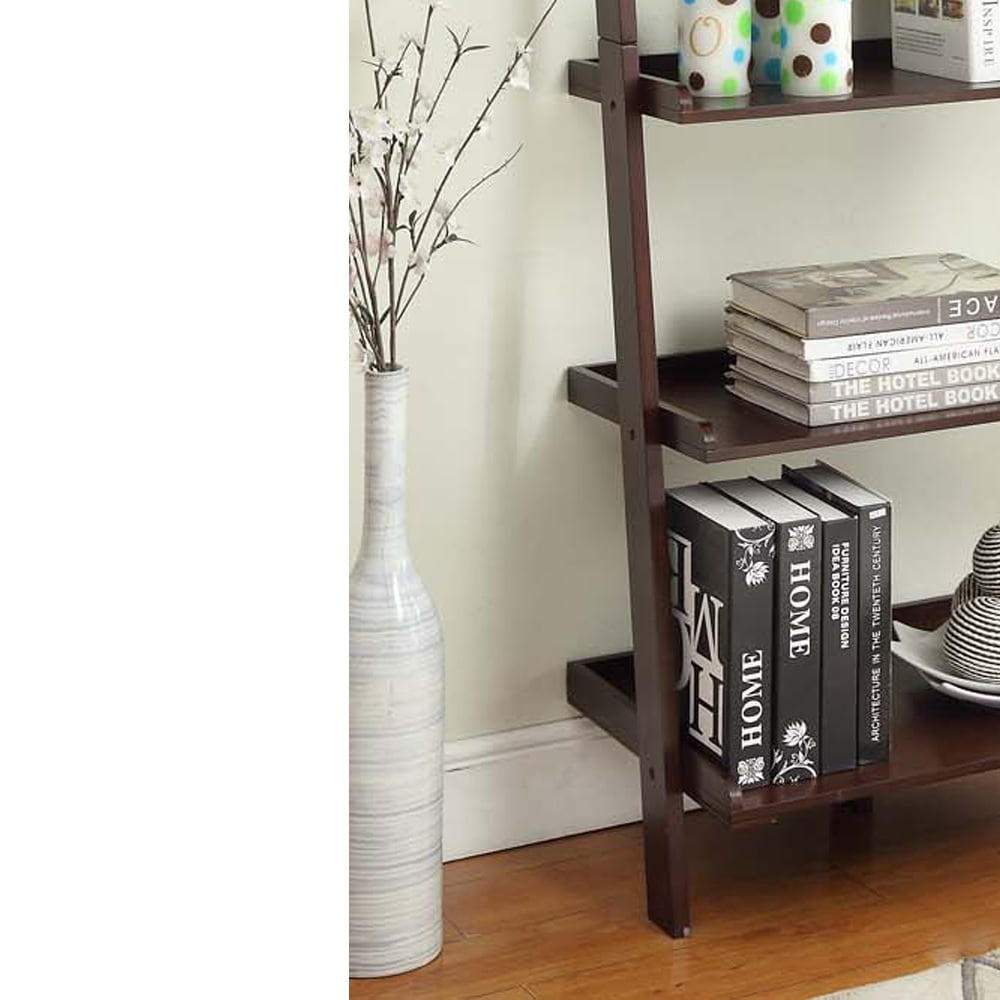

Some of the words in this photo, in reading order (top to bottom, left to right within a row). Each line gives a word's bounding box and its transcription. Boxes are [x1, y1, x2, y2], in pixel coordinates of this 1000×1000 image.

[980, 1, 998, 68] INSPIRE
[832, 357, 891, 378] DECOR
[832, 378, 872, 397] THE
[877, 368, 942, 391] HOTEL
[830, 400, 871, 420] THE
[875, 392, 938, 417] HOTEL
[944, 383, 999, 408] BOOK
[831, 543, 840, 570] IDEA
[871, 525, 883, 570] CENTURY
[831, 572, 840, 605] BOOK
[841, 541, 850, 605] FURNITURE
[789, 560, 811, 659] HOME
[840, 606, 850, 649] DESIGN
[871, 630, 881, 650] THE
[872, 653, 881, 664] IN
[741, 649, 763, 750] HOME
[871, 668, 881, 742] ARCHITECTURE
